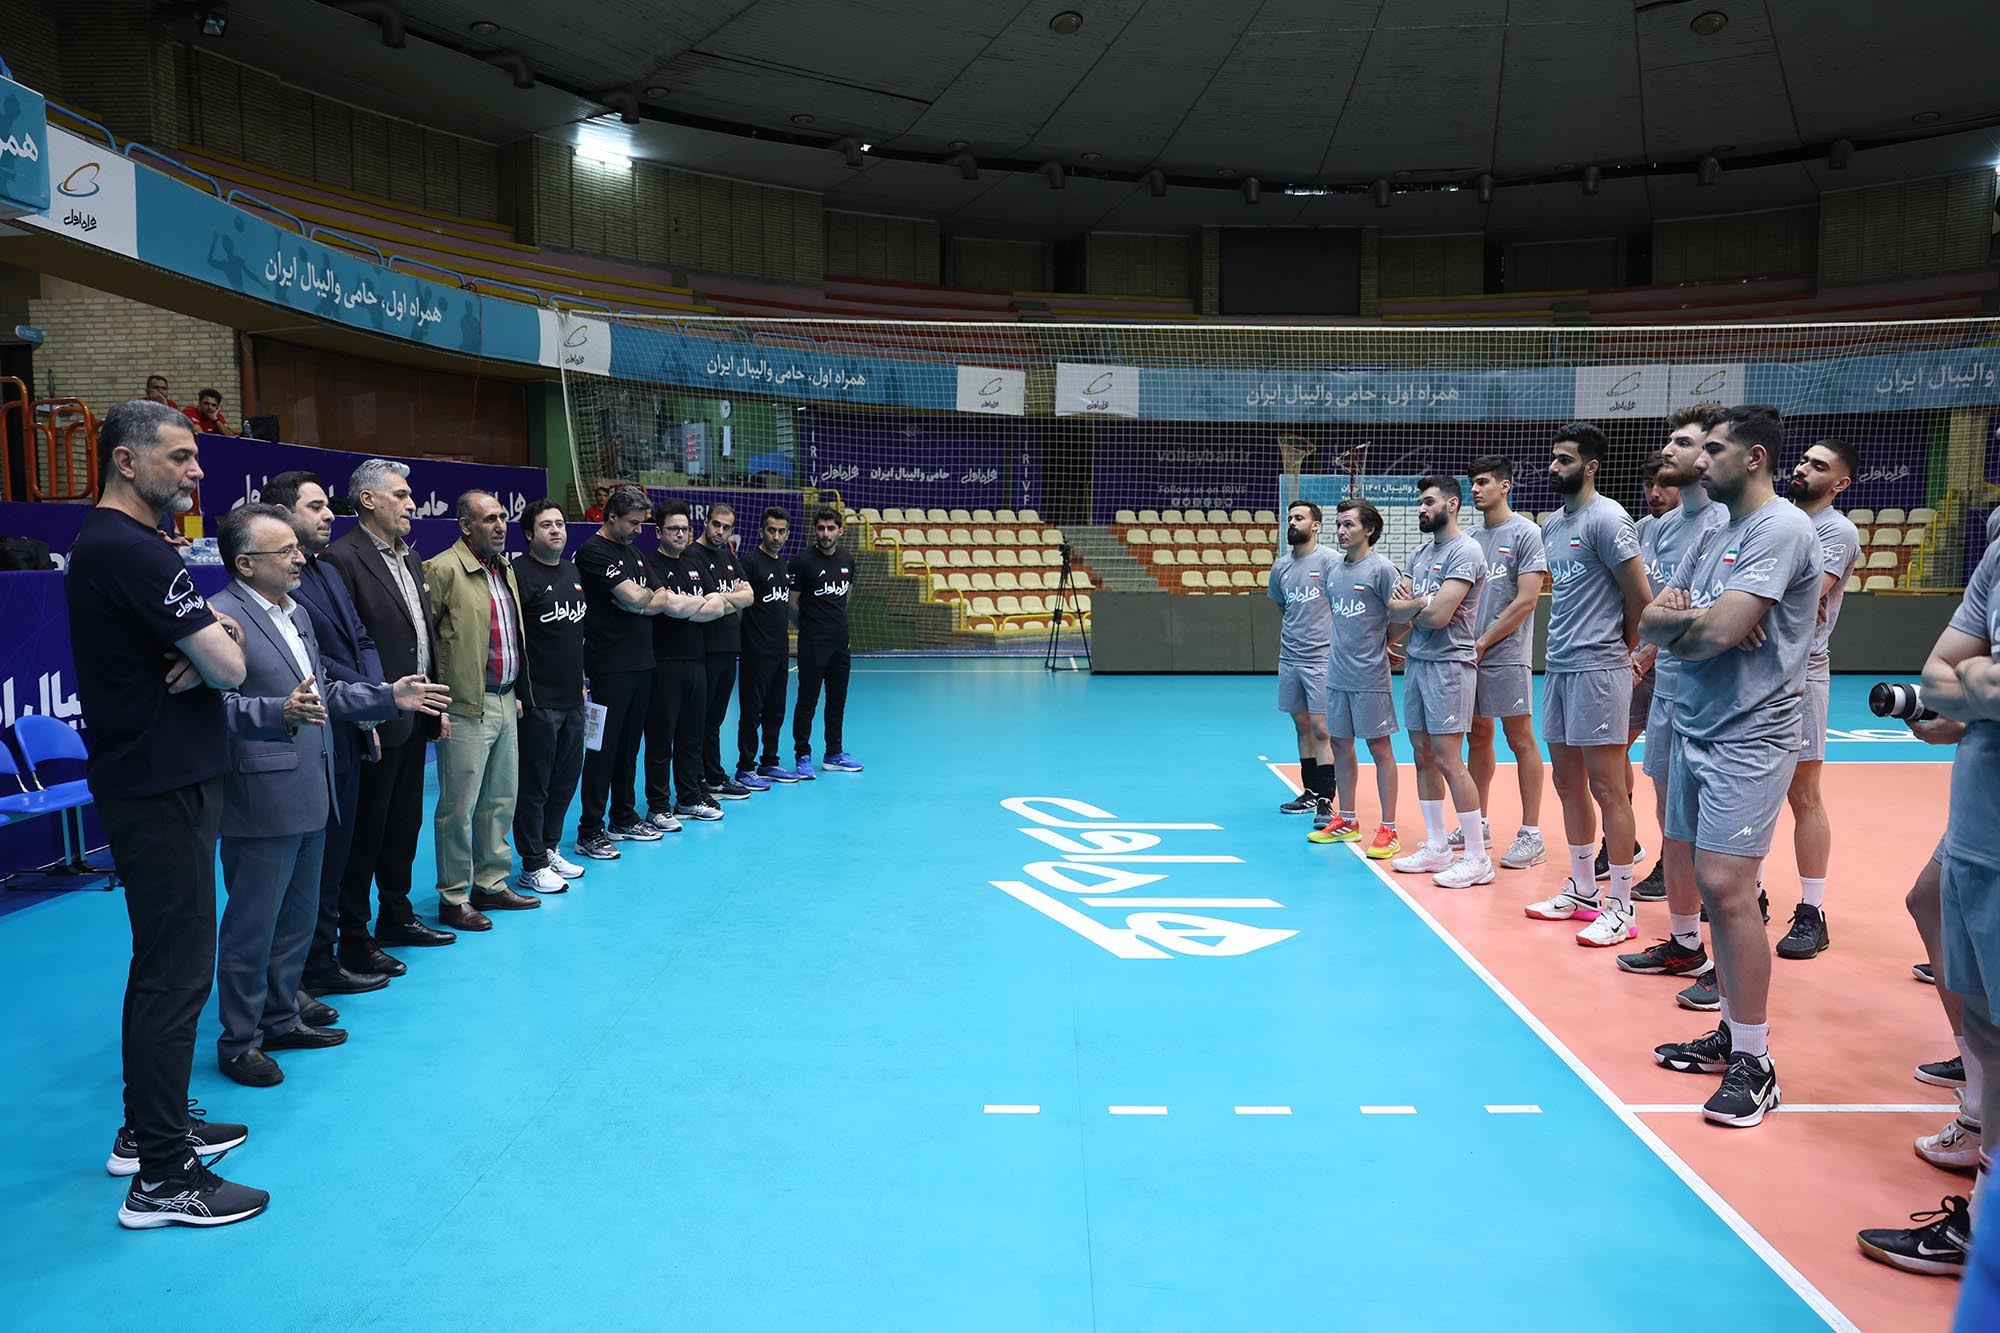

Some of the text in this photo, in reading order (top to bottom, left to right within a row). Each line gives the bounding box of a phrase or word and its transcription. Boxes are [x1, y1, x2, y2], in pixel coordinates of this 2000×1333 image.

[264, 251, 297, 287] ایران
[300, 261, 342, 304] والیبال
[343, 282, 378, 309] حامی
[409, 296, 442, 327] همراه
[706, 353, 734, 376] ایران
[736, 357, 773, 382] والیبال
[775, 365, 806, 384] حامی
[834, 369, 866, 390] همراه
[1876, 361, 1995, 393] والیبال ایران
[1246, 383, 1281, 406] ایران
[1284, 384, 1333, 407] والیبال
[1336, 384, 1377, 408] حامی
[1417, 383, 1460, 407] همراه
[870, 467, 949, 482] حامی والیبال ایران
[1159, 484, 1190, 494] Follow
[1193, 486, 1203, 494] us
